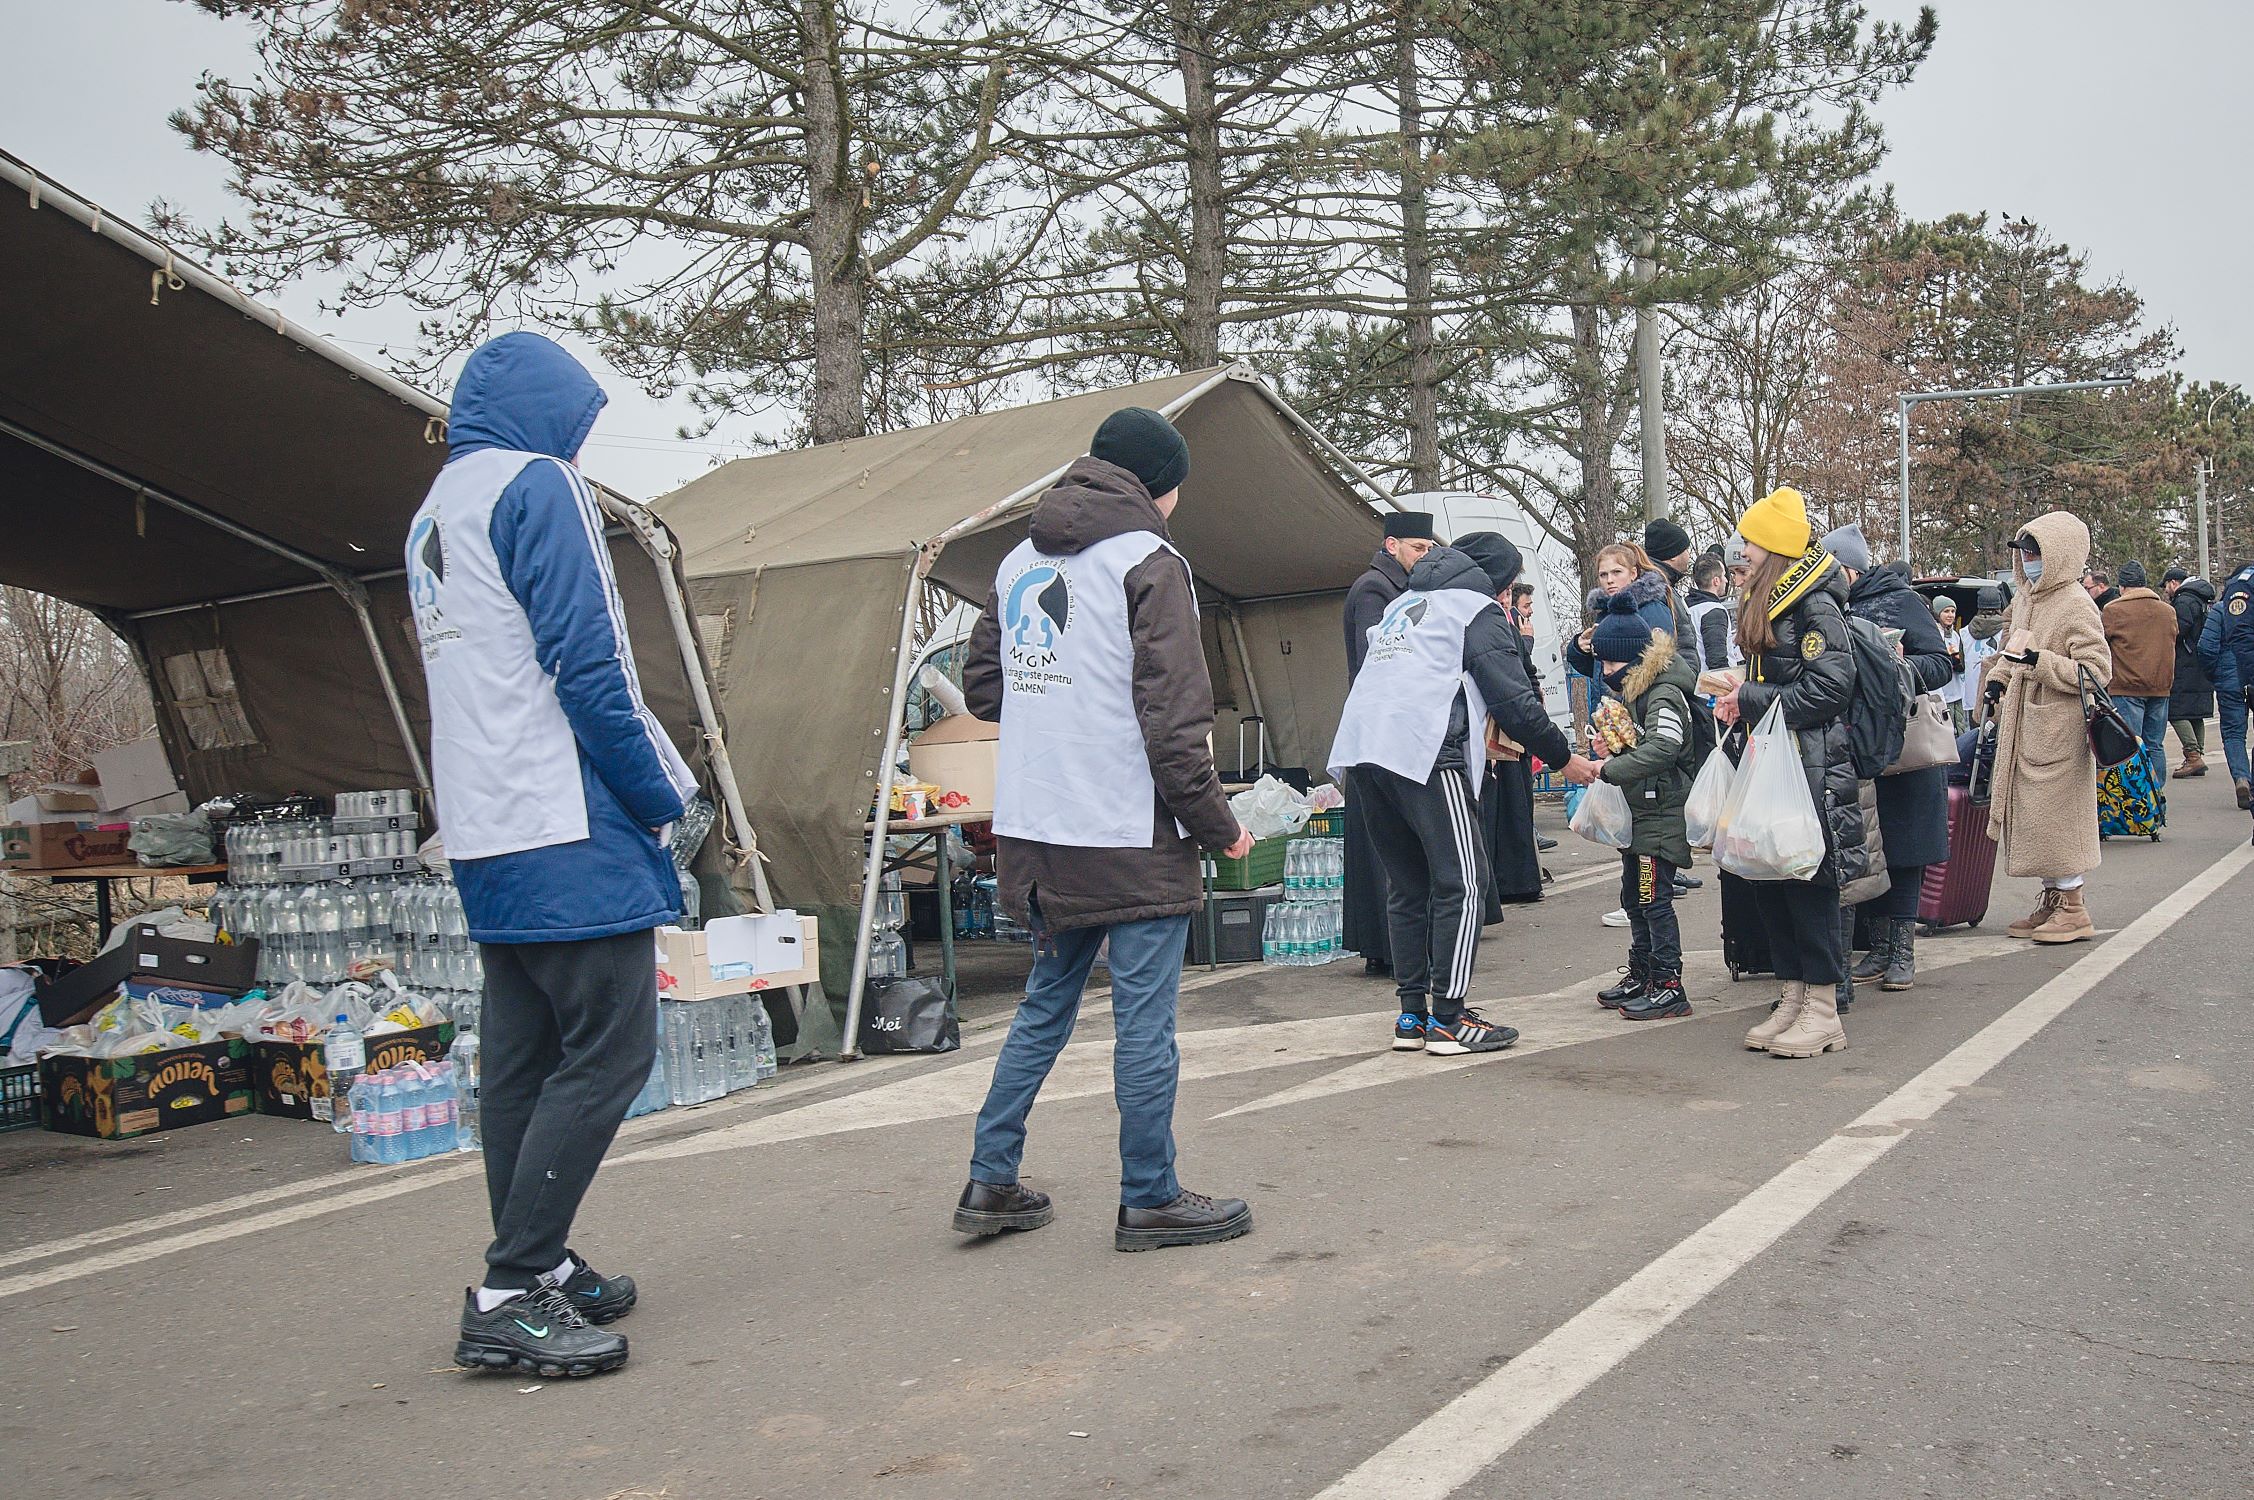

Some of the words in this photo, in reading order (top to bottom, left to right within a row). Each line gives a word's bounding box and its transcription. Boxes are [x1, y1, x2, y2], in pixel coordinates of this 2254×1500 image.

[1009, 645, 1057, 668] MGM
[1043, 672, 1072, 684] pentru
[1012, 681, 1046, 695] OAMENI
[871, 1015, 902, 1032] Mei
